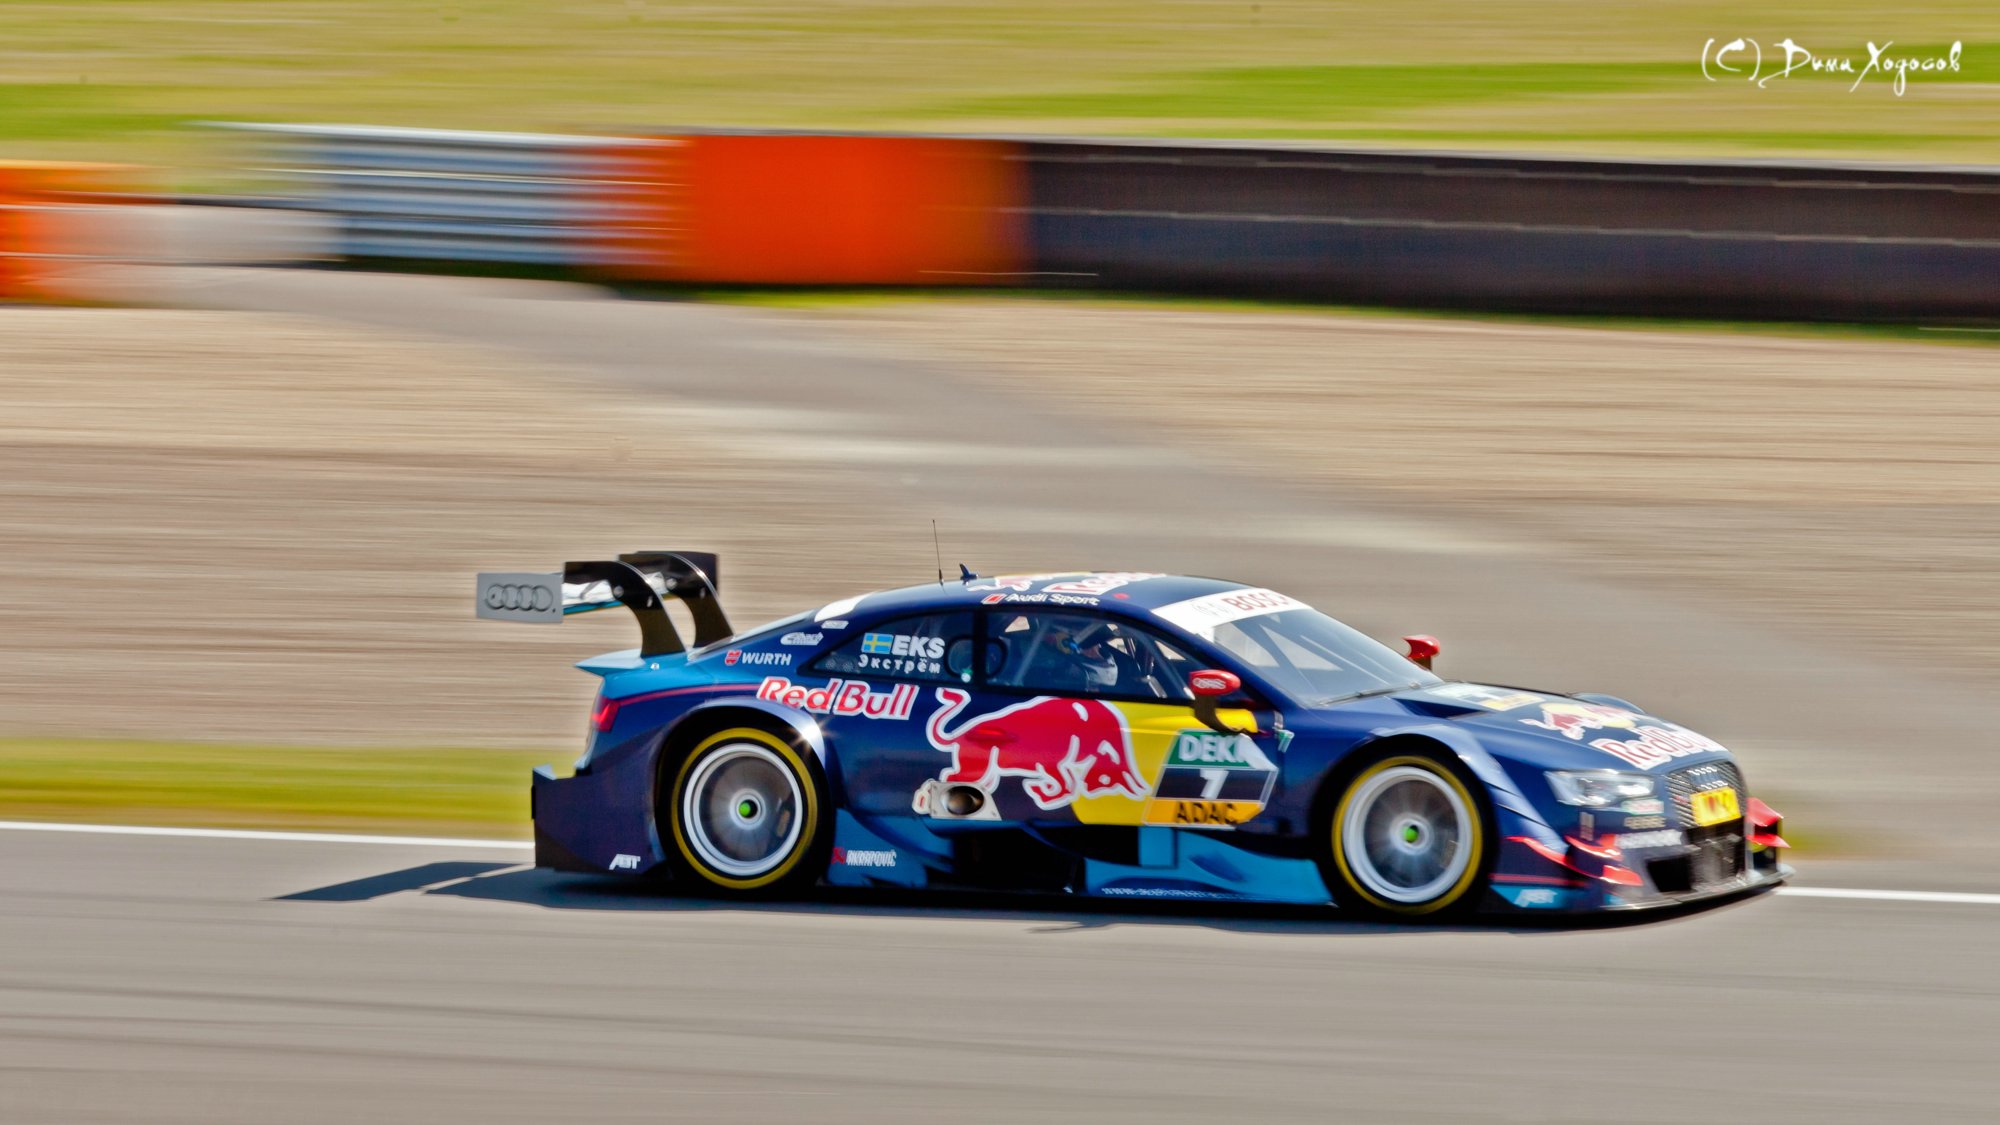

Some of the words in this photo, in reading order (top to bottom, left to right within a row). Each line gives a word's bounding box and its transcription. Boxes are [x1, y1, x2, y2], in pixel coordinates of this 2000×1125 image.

[1005, 593, 1049, 602] Audi
[1048, 594, 1100, 606] Sport
[891, 634, 945, 659] EKS
[858, 654, 941, 674] Экстрём
[1177, 801, 1239, 825] ADAC
